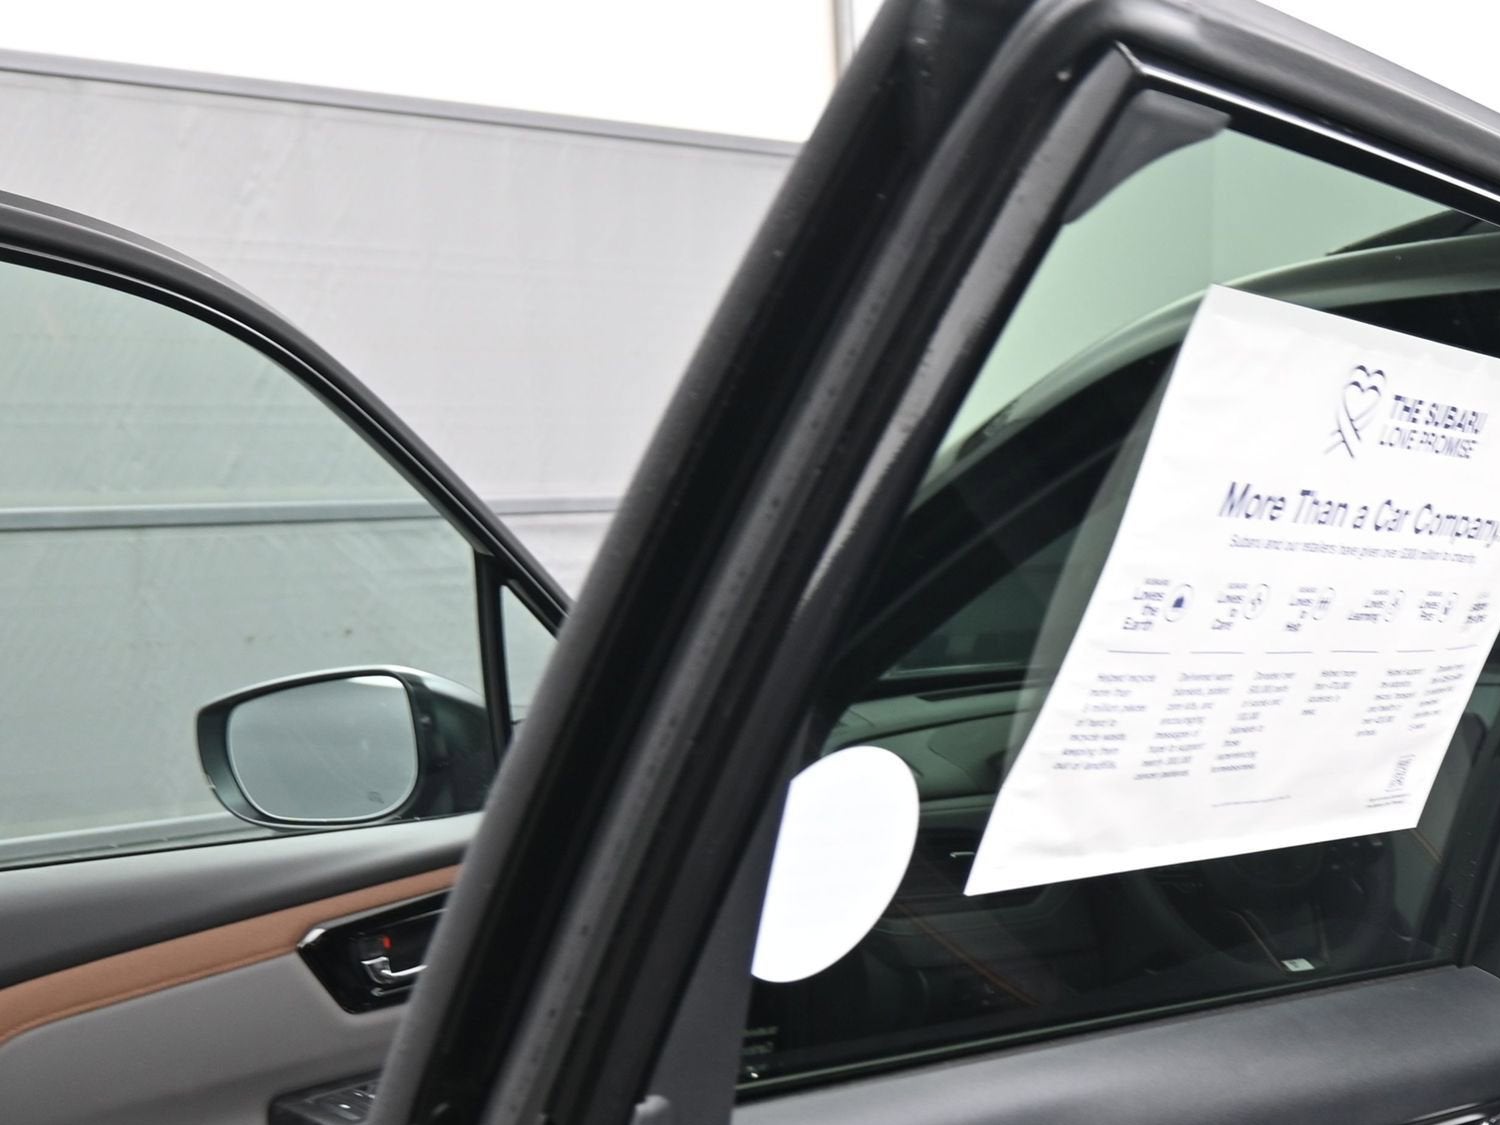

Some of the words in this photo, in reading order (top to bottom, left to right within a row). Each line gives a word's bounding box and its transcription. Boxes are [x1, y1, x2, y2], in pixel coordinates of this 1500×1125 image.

[1389, 394, 1425, 424] THE
[1424, 402, 1489, 434] SUBARU
[1376, 424, 1419, 451] LOVE
[1418, 430, 1477, 460] PROMISE
[1217, 481, 1286, 520] More
[1292, 489, 1349, 527] Than
[1352, 506, 1369, 529] a
[1374, 499, 1412, 532] Car
